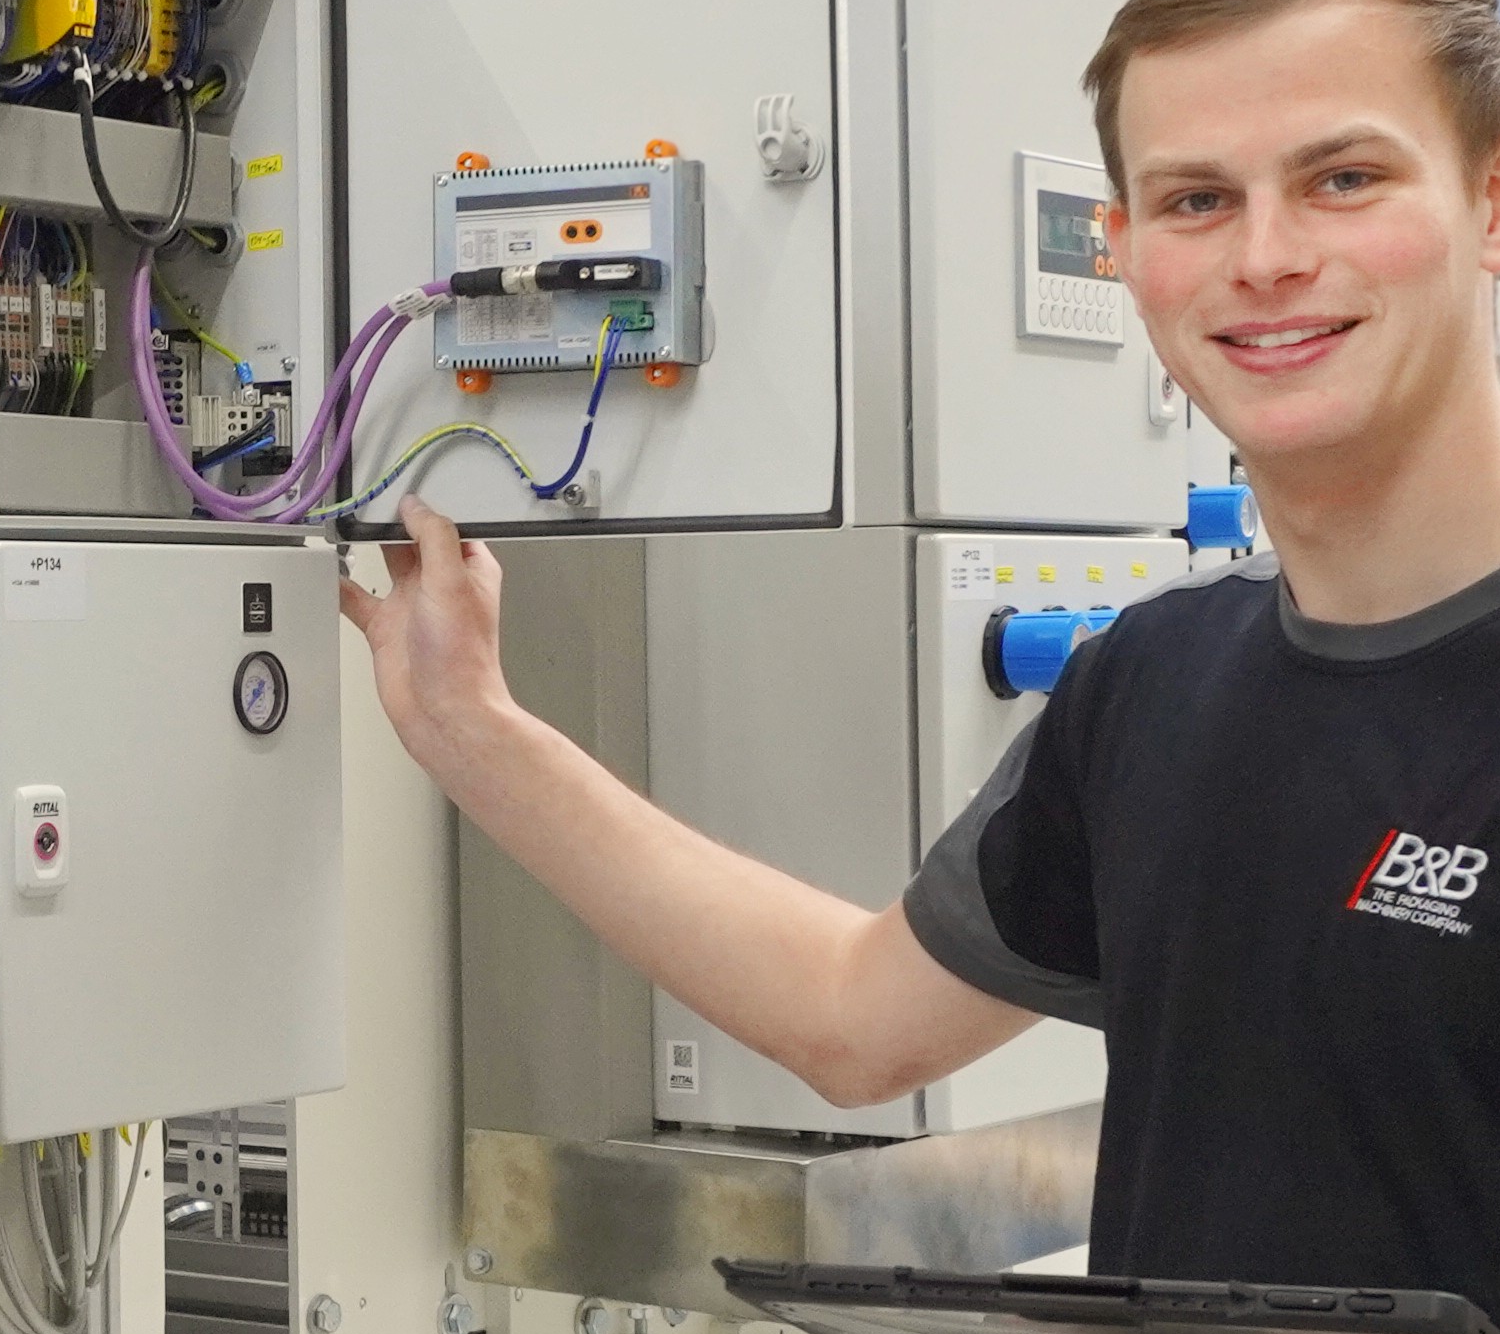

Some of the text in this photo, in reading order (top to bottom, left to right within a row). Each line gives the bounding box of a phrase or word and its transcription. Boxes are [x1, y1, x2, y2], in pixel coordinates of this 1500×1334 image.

[30, 557, 61, 571] +P134
[33, 802, 59, 814] RITTAL
[1371, 832, 1489, 901] B&B
[1372, 887, 1461, 918] THE PACKAGING
[1355, 898, 1473, 936] MACHINERY COMPANY
[670, 1075, 693, 1084] RITTAL
